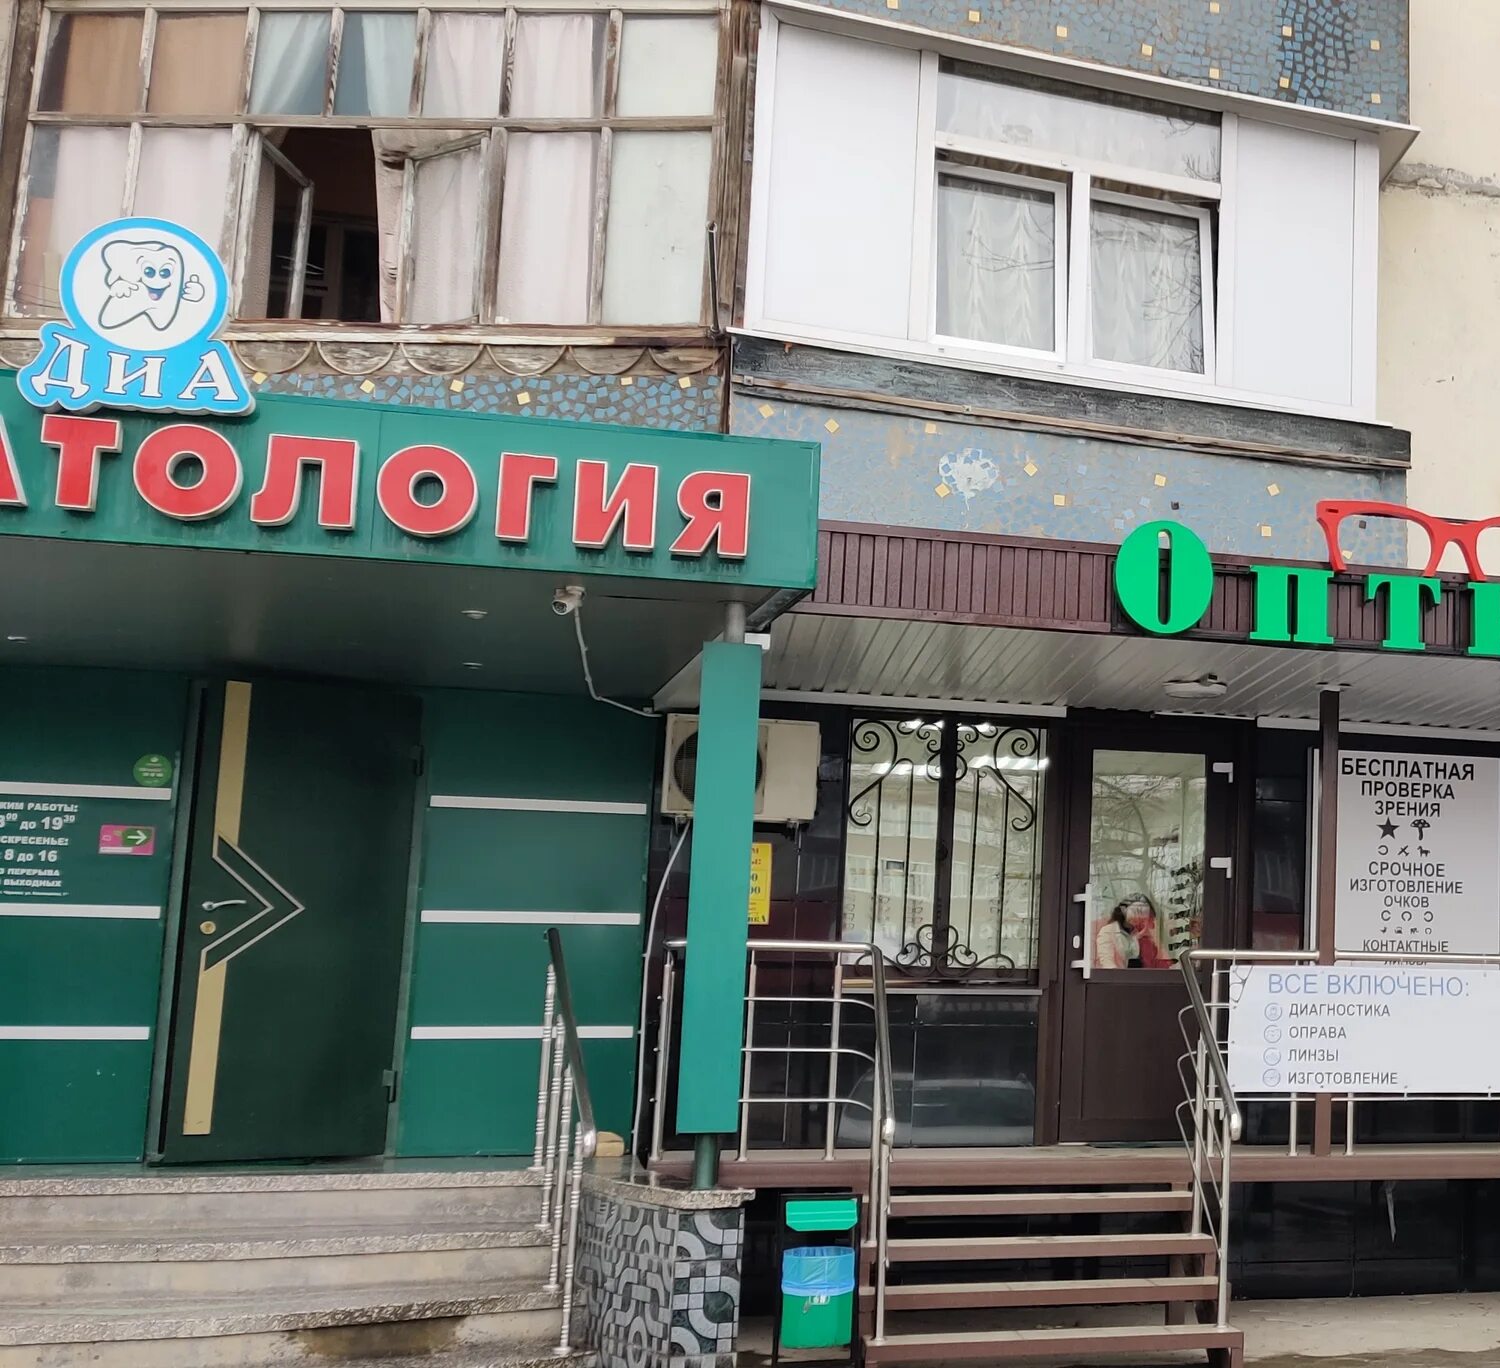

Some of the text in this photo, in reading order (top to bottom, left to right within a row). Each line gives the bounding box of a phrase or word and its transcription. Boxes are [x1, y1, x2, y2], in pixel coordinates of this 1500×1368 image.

[31, 333, 241, 402] ДИА
[0, 413, 753, 561] ТОЛОГИЯ
[1341, 757, 1475, 781] БЕСПЛАТНАЯ
[1361, 780, 1455, 800] ПРОВЕРКА
[27, 803, 79, 812] РАБОТЫ:
[1374, 800, 1441, 817] ЗРЕНИЯ
[20, 821, 37, 830] до
[4, 848, 58, 862] 8 до 16
[7, 868, 60, 876] ПЕРЕРЫВА
[1368, 861, 1446, 877] СРОЧНОЕ
[4, 879, 62, 887] ВЫХОДНЫХ
[1350, 878, 1464, 895] ИЗГОТОВЛЕНИЕ
[1383, 895, 1430, 908] ОЧКОВ
[1363, 939, 1449, 953] КОНТАКТНЫЕ
[1268, 974, 1470, 997] ВСЕ ВКЛЮЧЕНО:
[1288, 1003, 1391, 1018] ДИАГНОСТИКА
[1288, 1026, 1347, 1039] ОПРАВА
[1287, 1048, 1339, 1062] ЛИНЗЫ
[1287, 1072, 1399, 1085] ИЗГОТОВЛЕНИЕ
